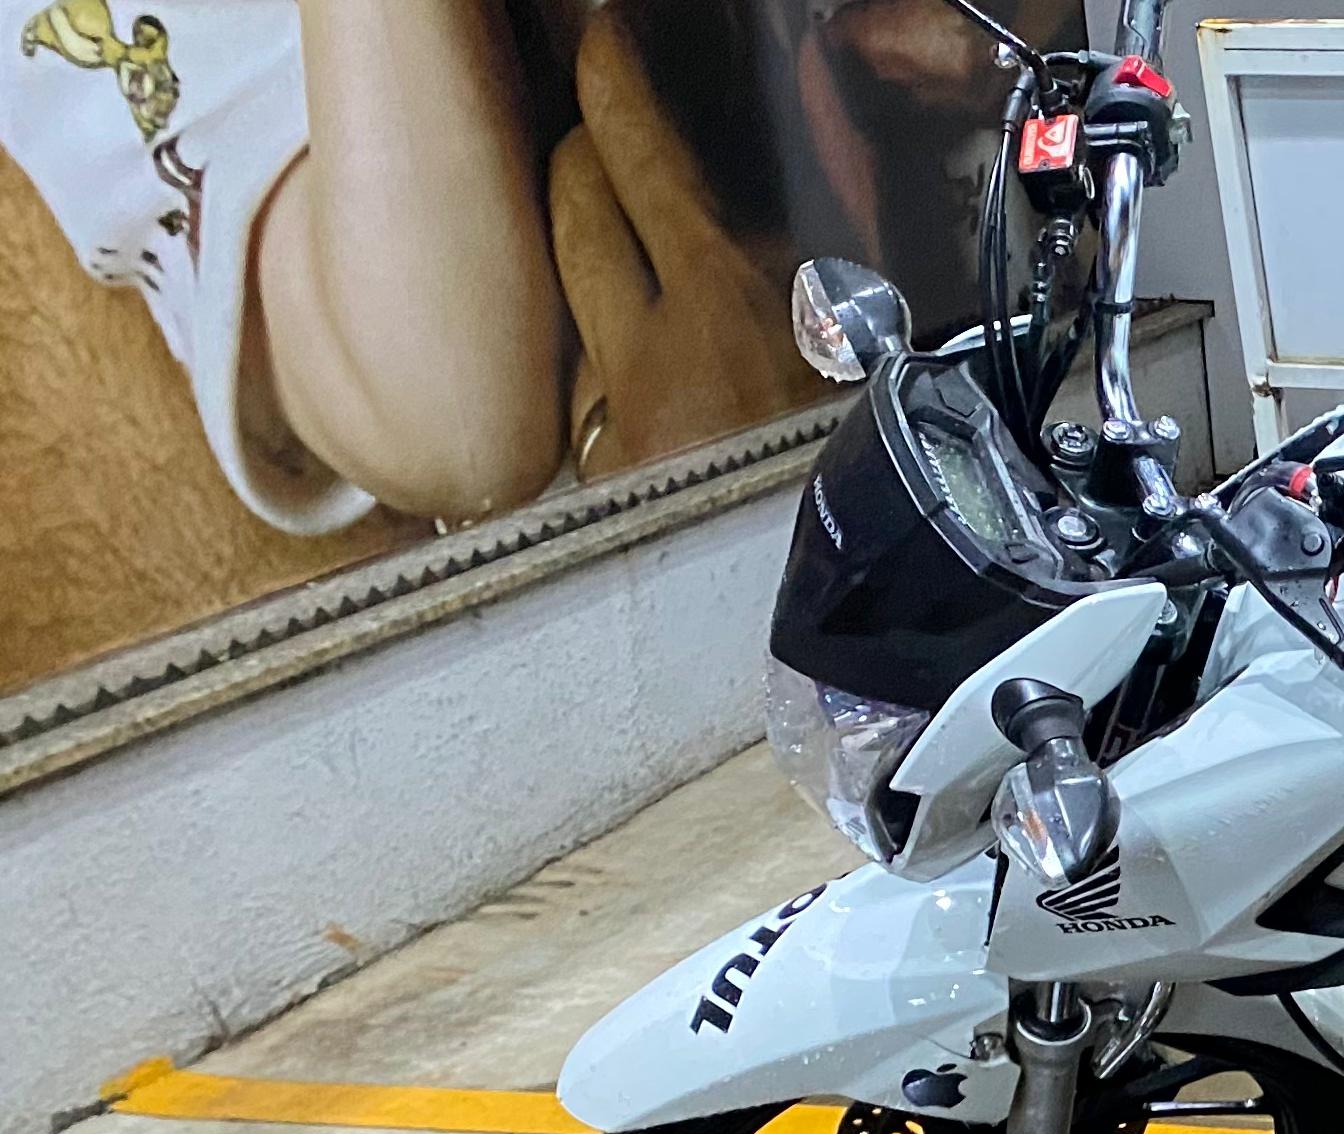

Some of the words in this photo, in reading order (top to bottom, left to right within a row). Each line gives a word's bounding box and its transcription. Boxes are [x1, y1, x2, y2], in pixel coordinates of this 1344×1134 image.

[814, 472, 842, 549] HONDA
[689, 874, 836, 1035] OTUL
[1056, 914, 1176, 934] HONDA
